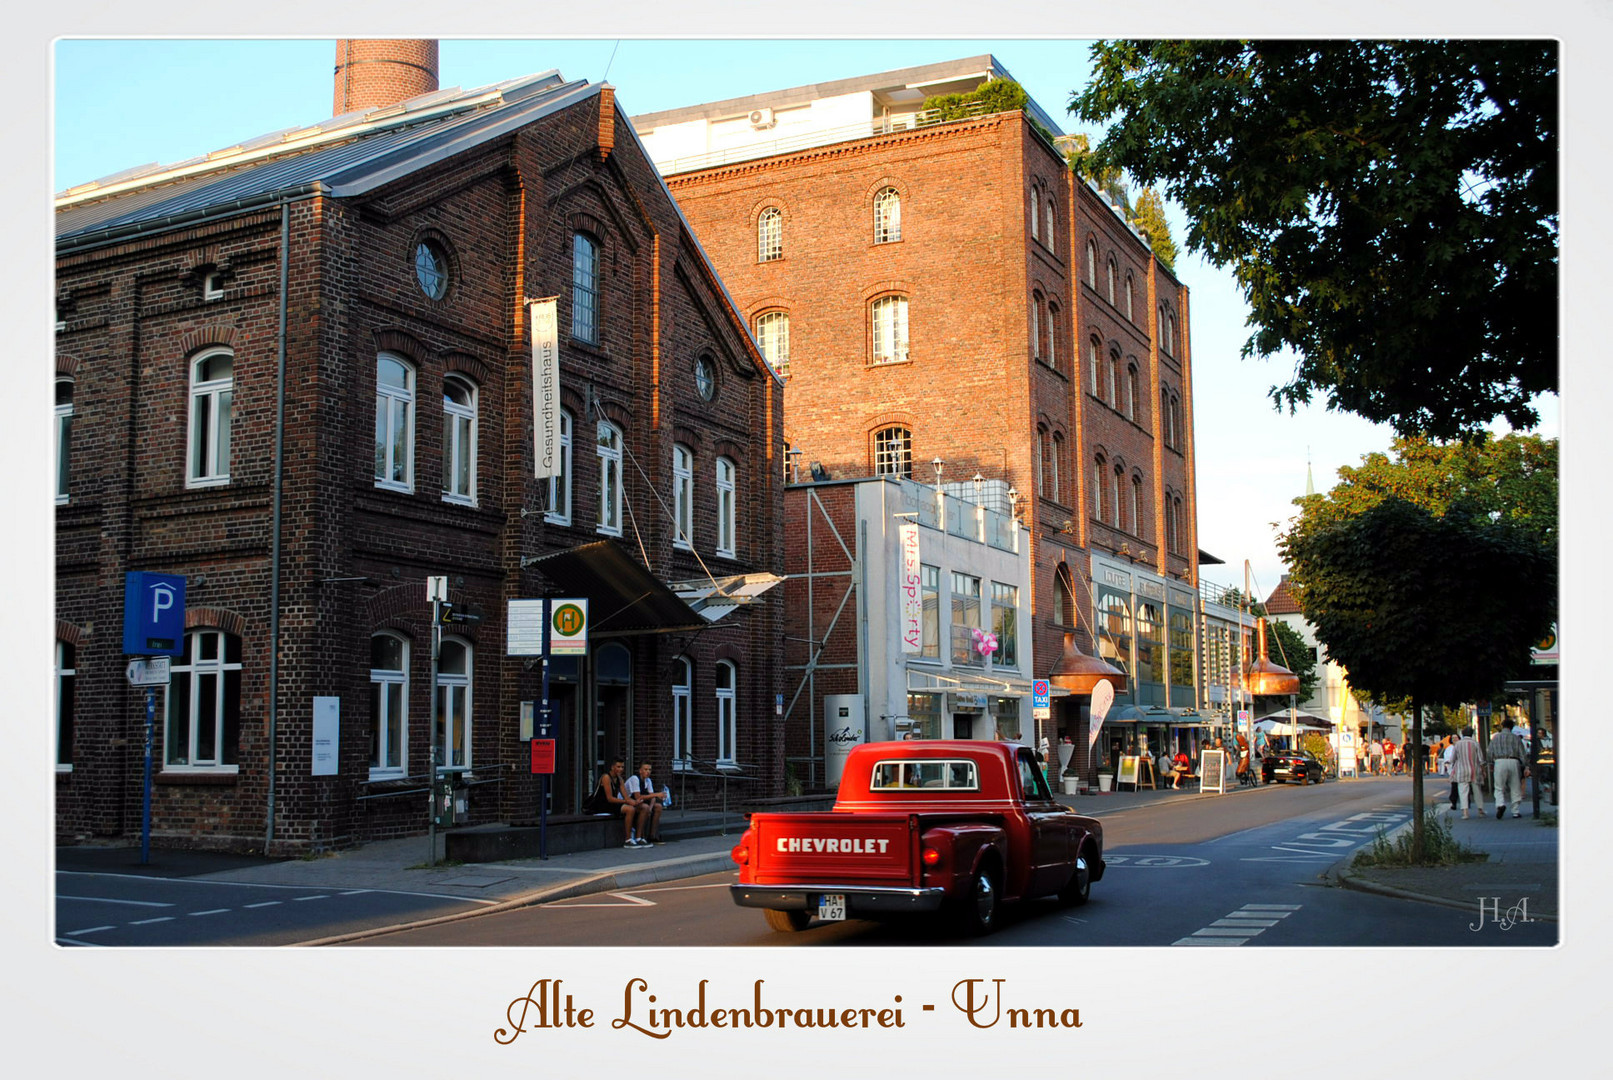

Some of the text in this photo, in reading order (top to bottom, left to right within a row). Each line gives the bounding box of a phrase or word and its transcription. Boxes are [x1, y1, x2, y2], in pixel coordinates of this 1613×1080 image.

[541, 341, 553, 469] Gesundheitshaus
[153, 588, 174, 623] P
[562, 610, 575, 629] H
[777, 838, 890, 853] CHEVROLET
[824, 895, 838, 906] HA
[820, 908, 843, 918] V 67
